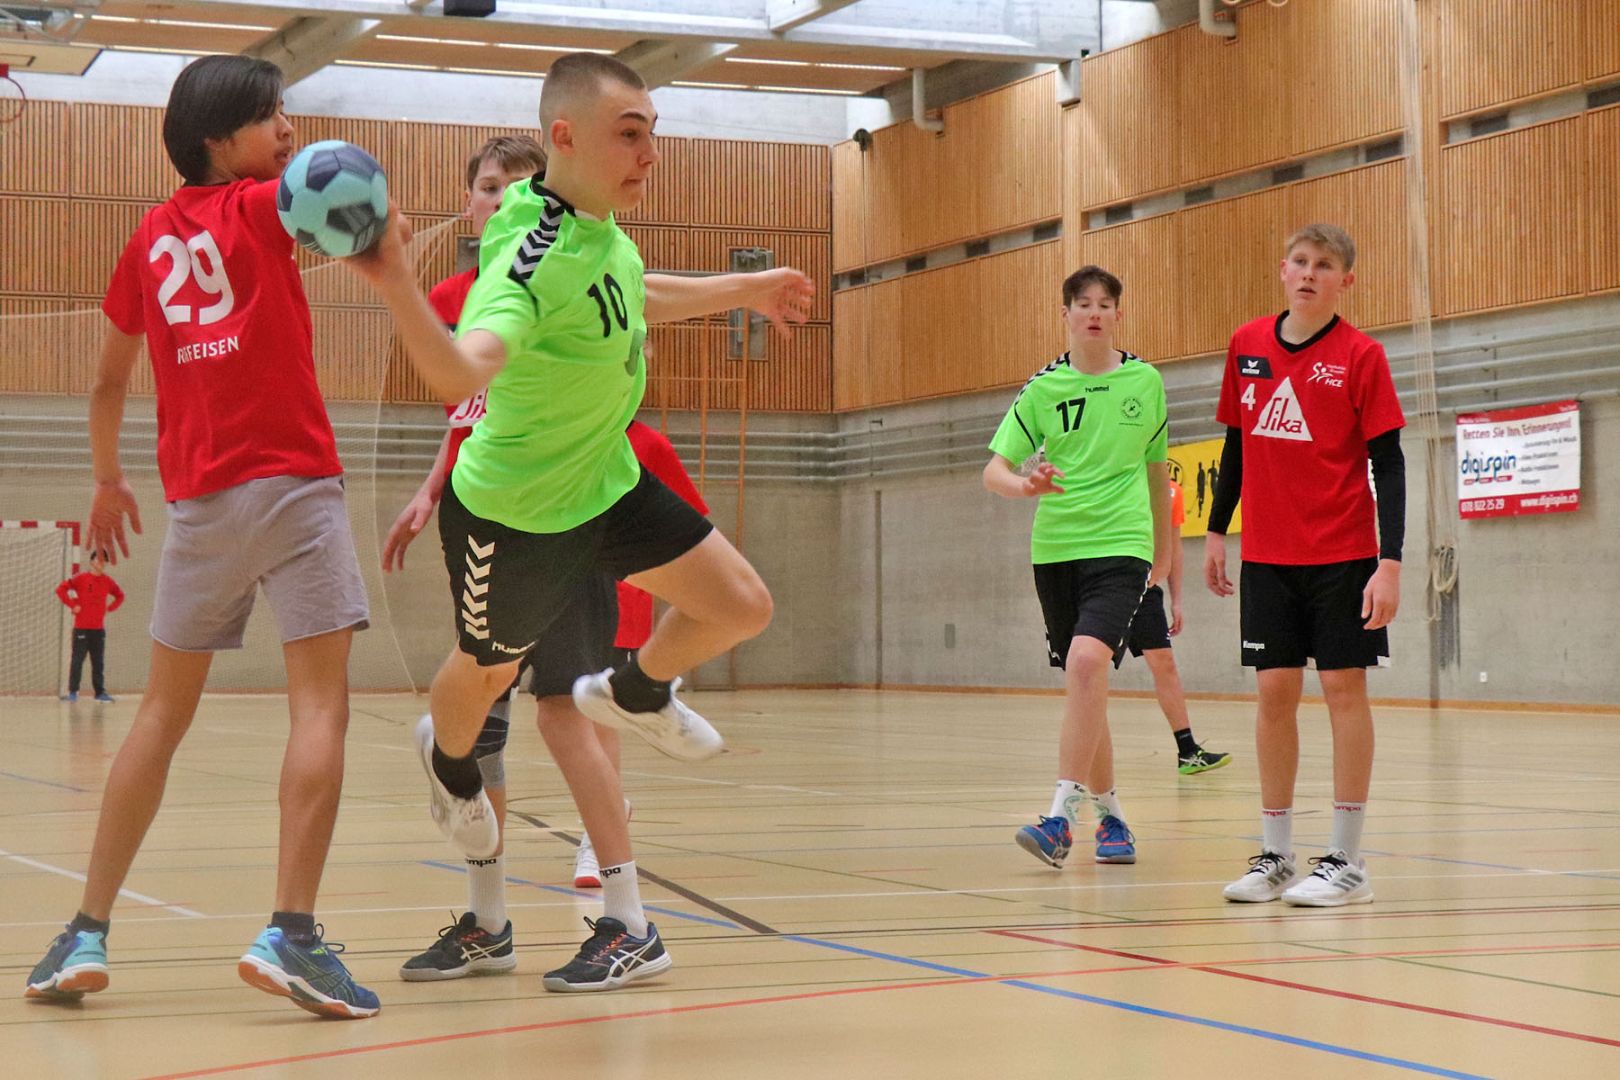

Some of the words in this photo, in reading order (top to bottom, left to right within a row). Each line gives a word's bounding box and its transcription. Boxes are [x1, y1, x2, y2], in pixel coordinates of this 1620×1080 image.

[149, 230, 235, 326] 29
[587, 272, 628, 338] 10
[1240, 383, 1256, 411] 4
[1324, 377, 1344, 388] HCE
[1056, 397, 1086, 433] 17
[1261, 397, 1302, 434] Sika
[1492, 426, 1505, 439] Sie
[1461, 450, 1517, 482] digispin
